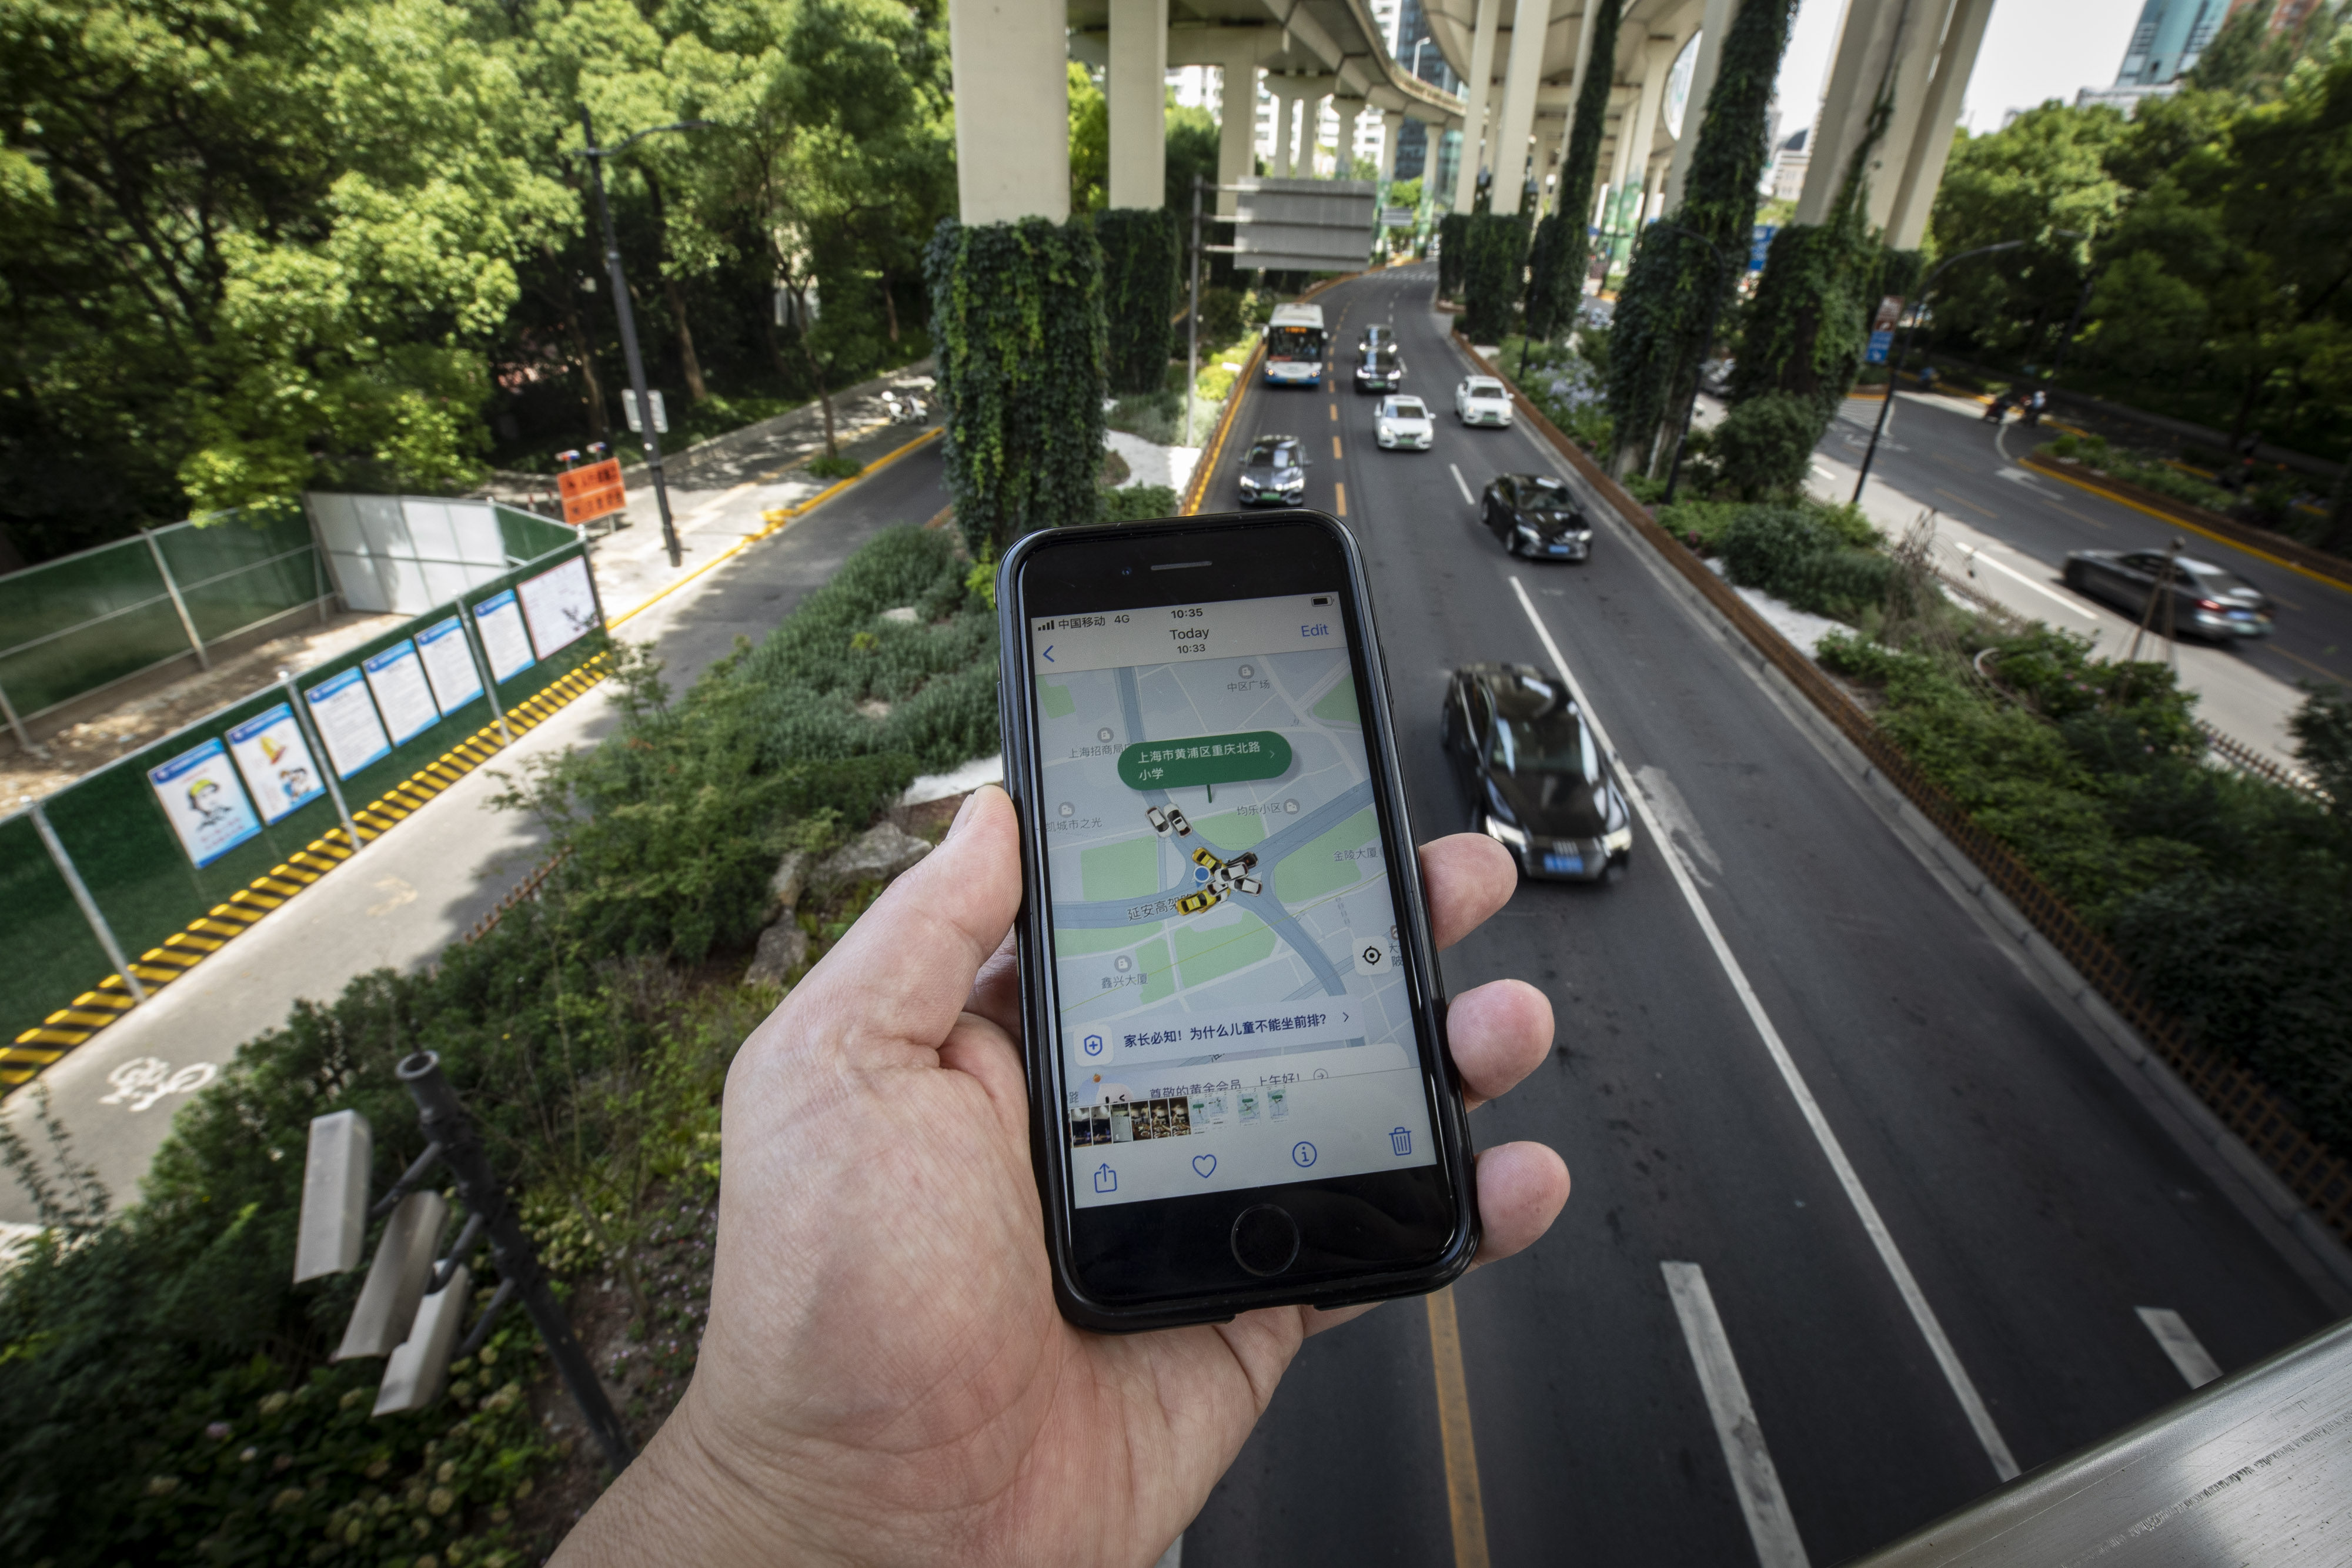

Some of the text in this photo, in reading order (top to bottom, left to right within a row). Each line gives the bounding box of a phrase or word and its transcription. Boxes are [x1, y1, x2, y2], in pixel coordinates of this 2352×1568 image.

[1171, 608, 1203, 618] 10:35
[1058, 614, 1130, 630] 中国移动 4G
[1169, 627, 1210, 640] Today
[1301, 624, 1329, 637] Edit
[1177, 644, 1206, 654] 10:33
[1227, 680, 1270, 693] 中区广场
[1138, 741, 1261, 764] 上海市黄浦区重庆北路
[1138, 767, 1164, 781] 小学
[1237, 803, 1282, 816] 均乐小区
[1333, 847, 1378, 862] 金陵大厦
[1127, 893, 1192, 921] 延安高架
[1101, 973, 1148, 989] 鑫兴大厦
